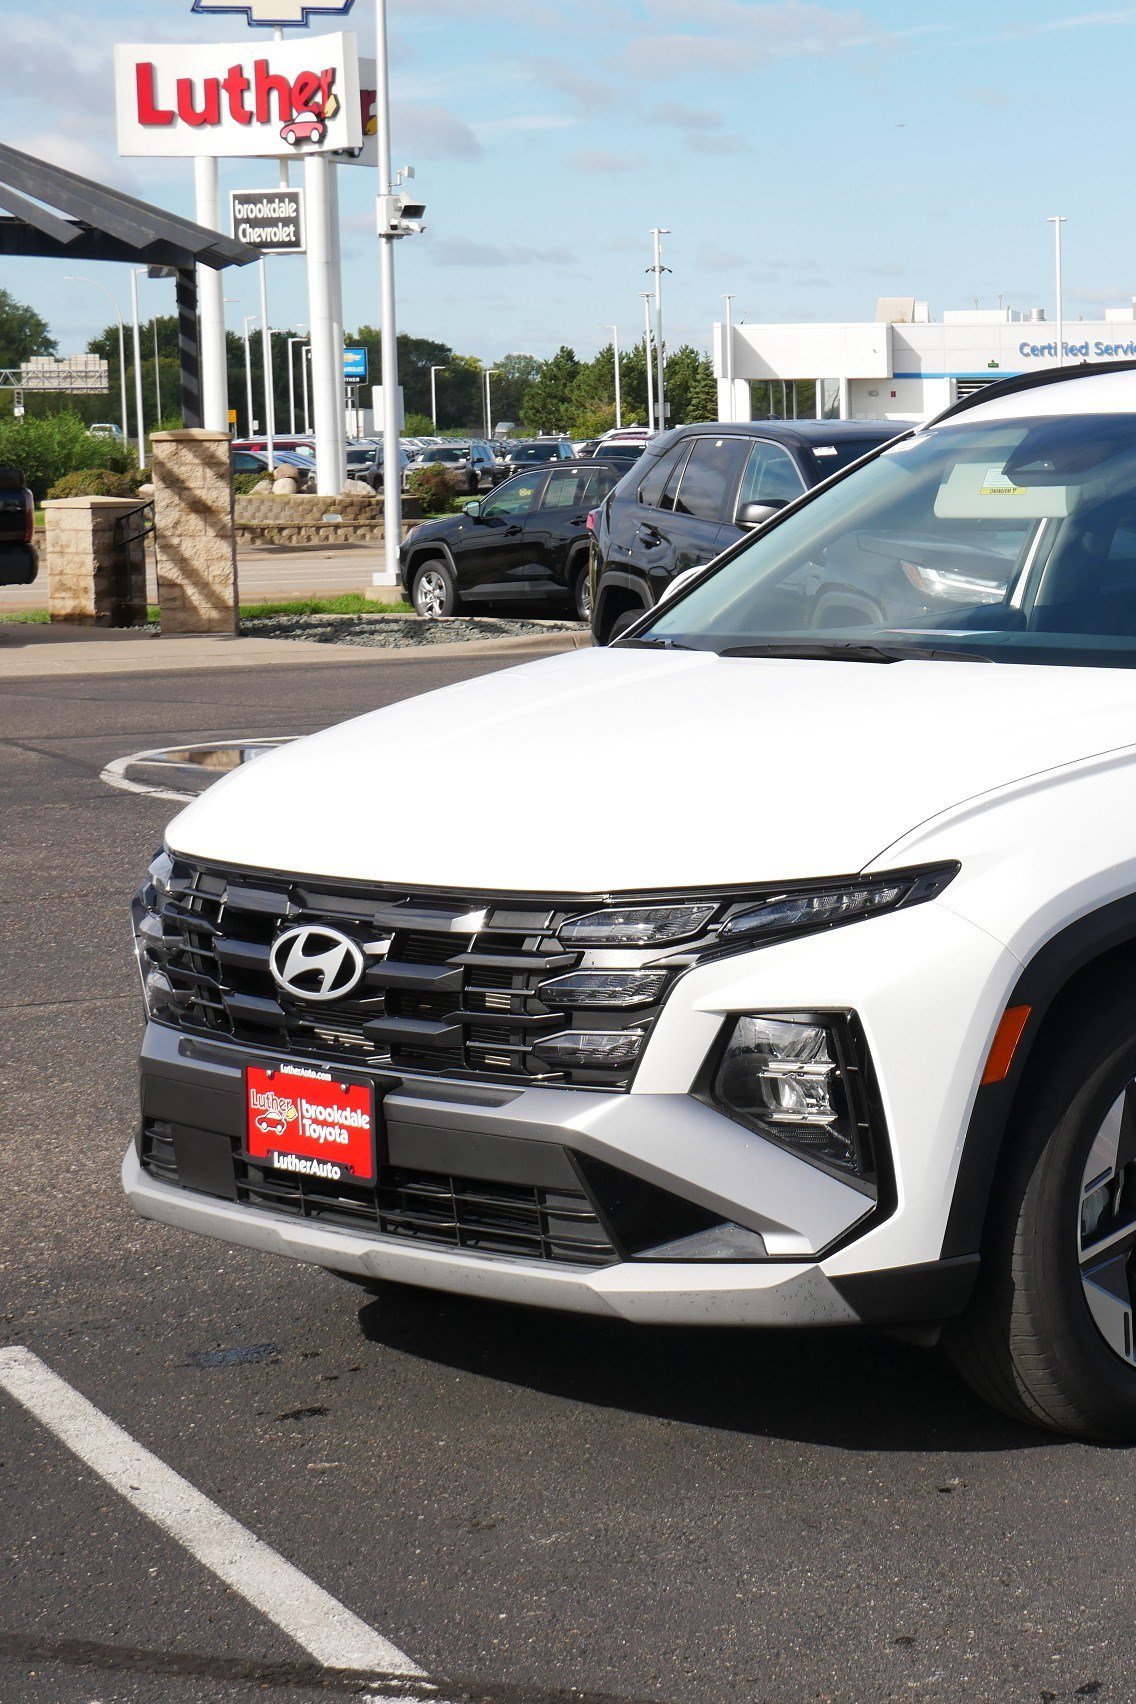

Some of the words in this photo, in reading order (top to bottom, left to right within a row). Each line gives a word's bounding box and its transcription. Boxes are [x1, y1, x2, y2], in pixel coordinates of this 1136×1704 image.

[136, 58, 337, 127] Luther
[234, 198, 298, 219] brookdale
[238, 222, 297, 243] Chevrolet
[280, 1063, 332, 1082] LutherAuto.com
[250, 1088, 293, 1112] Luther
[301, 1098, 371, 1129] brookdale
[302, 1118, 349, 1144] Toyota
[273, 1151, 341, 1180] LutherAuto
